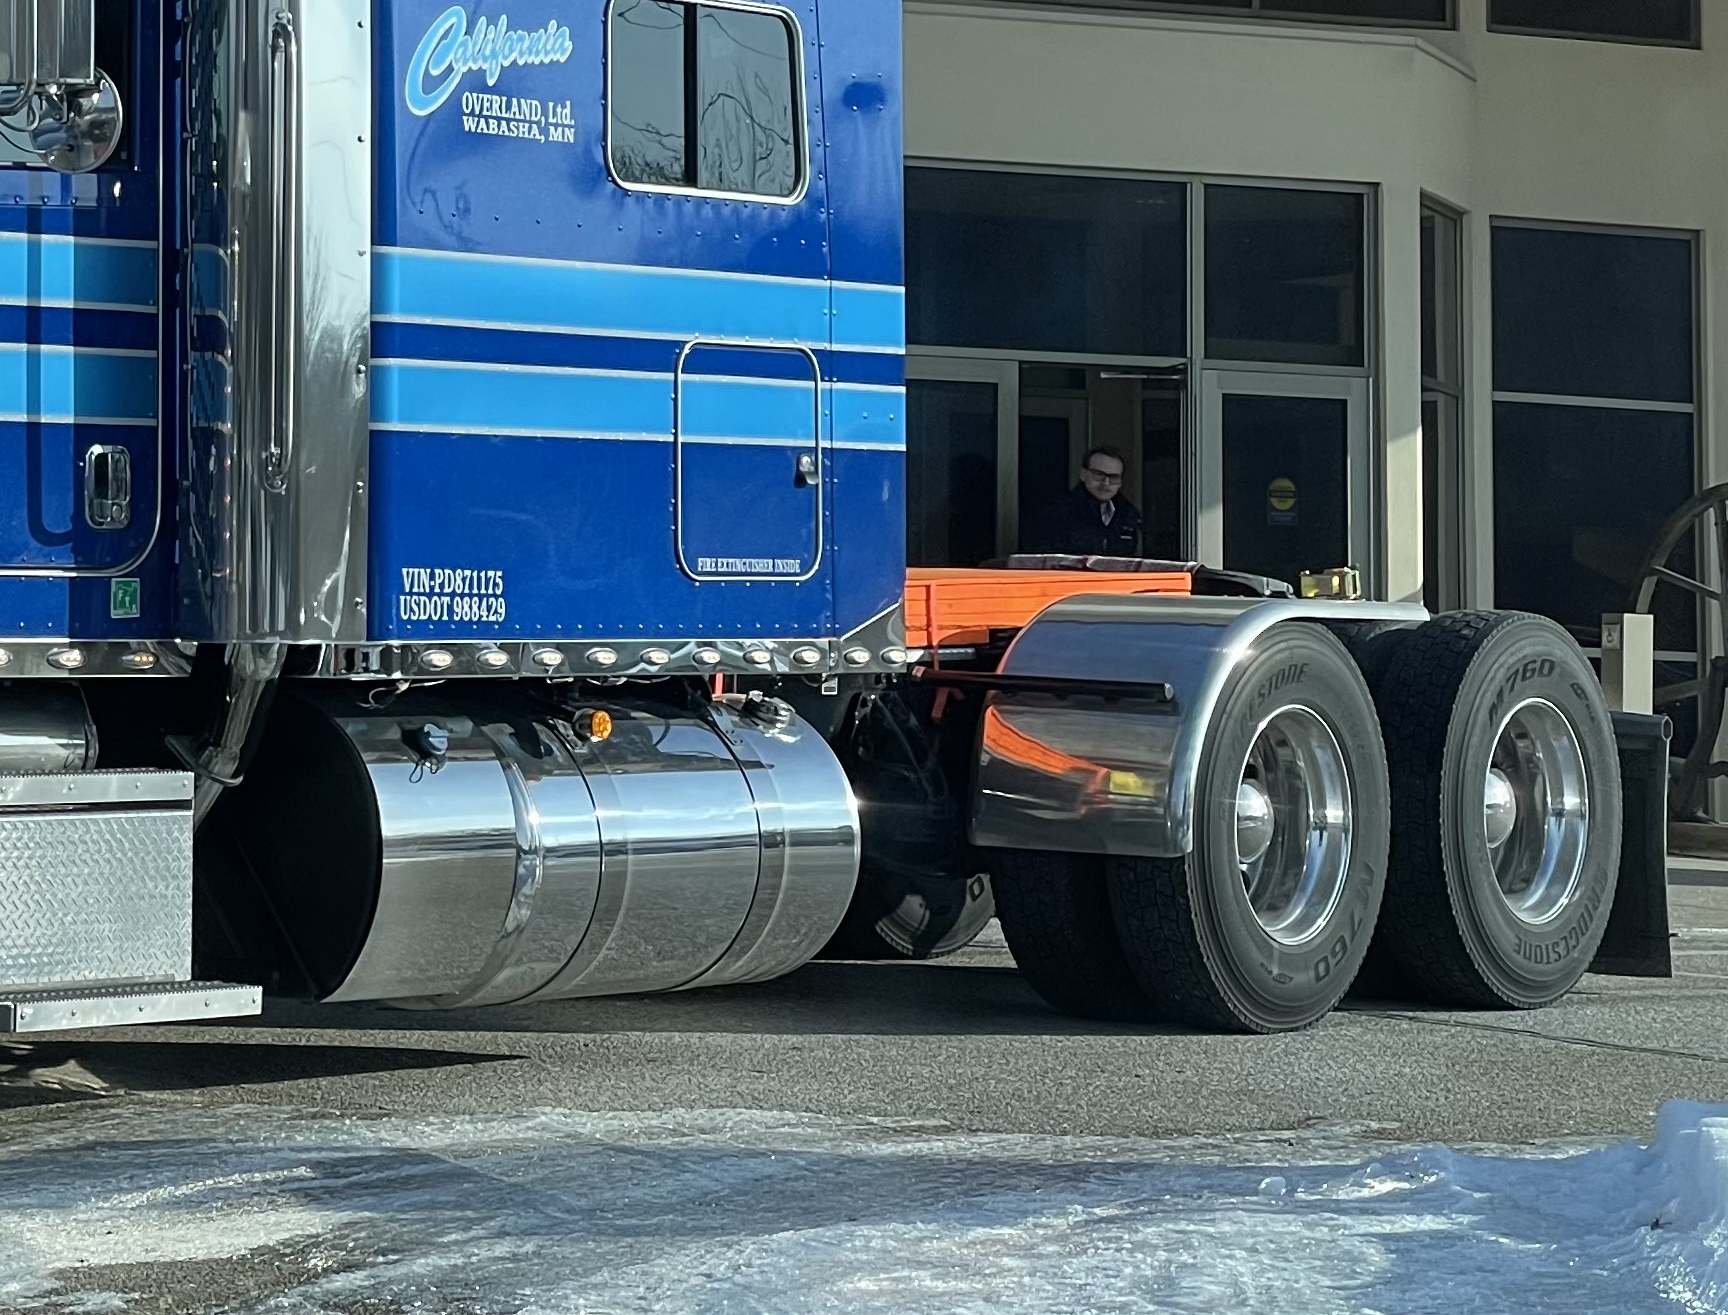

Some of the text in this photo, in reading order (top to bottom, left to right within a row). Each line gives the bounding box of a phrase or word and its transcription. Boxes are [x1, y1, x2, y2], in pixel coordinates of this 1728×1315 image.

[405, 5, 573, 116] California
[462, 91, 575, 127] OVERLAND, Ltd.
[462, 115, 575, 143] WABASHA, MN
[401, 567, 504, 595] VIN-PD871175
[399, 595, 506, 622] USDOT 988429
